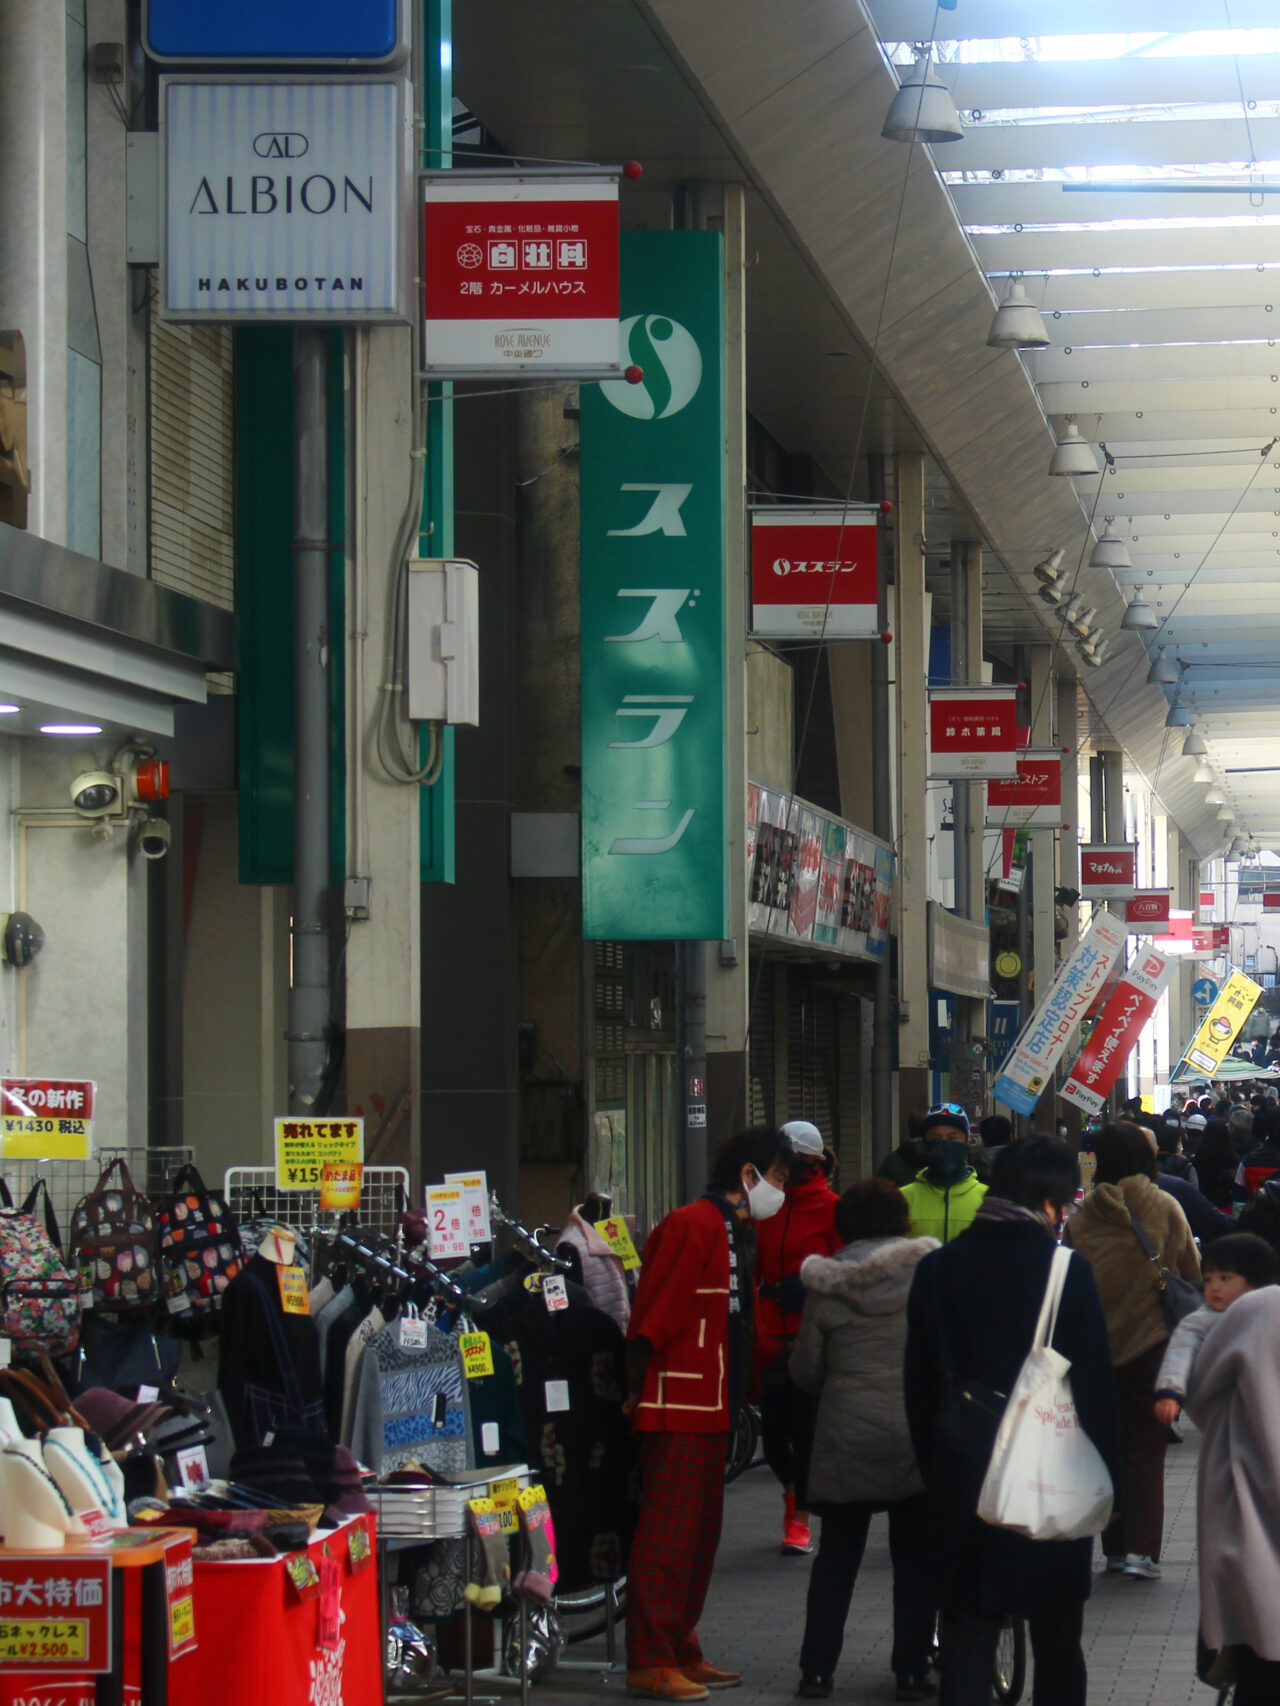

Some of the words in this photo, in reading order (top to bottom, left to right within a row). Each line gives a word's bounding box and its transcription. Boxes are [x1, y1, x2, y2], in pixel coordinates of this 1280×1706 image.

[189, 174, 374, 214] ALBION
[199, 277, 364, 292] HAKUBOTAN
[460, 281, 483, 295] 2階
[490, 281, 586, 295] カーメルハウス
[495, 334, 515, 348] ROSE
[517, 334, 552, 348] AVENUE
[791, 561, 857, 572] スズラン
[603, 483, 700, 855] スズラン
[1132, 970, 1159, 991] PayPay
[1025, 945, 1098, 1055] 対策認定店
[1086, 994, 1143, 1084] ペイペイ使えます
[1076, 1088, 1099, 1108] PayPay
[5, 1120, 54, 1132] ¥1430
[59, 1120, 85, 1134] 税込
[283, 1122, 357, 1139] 売れてます
[434, 1209, 447, 1231] 2
